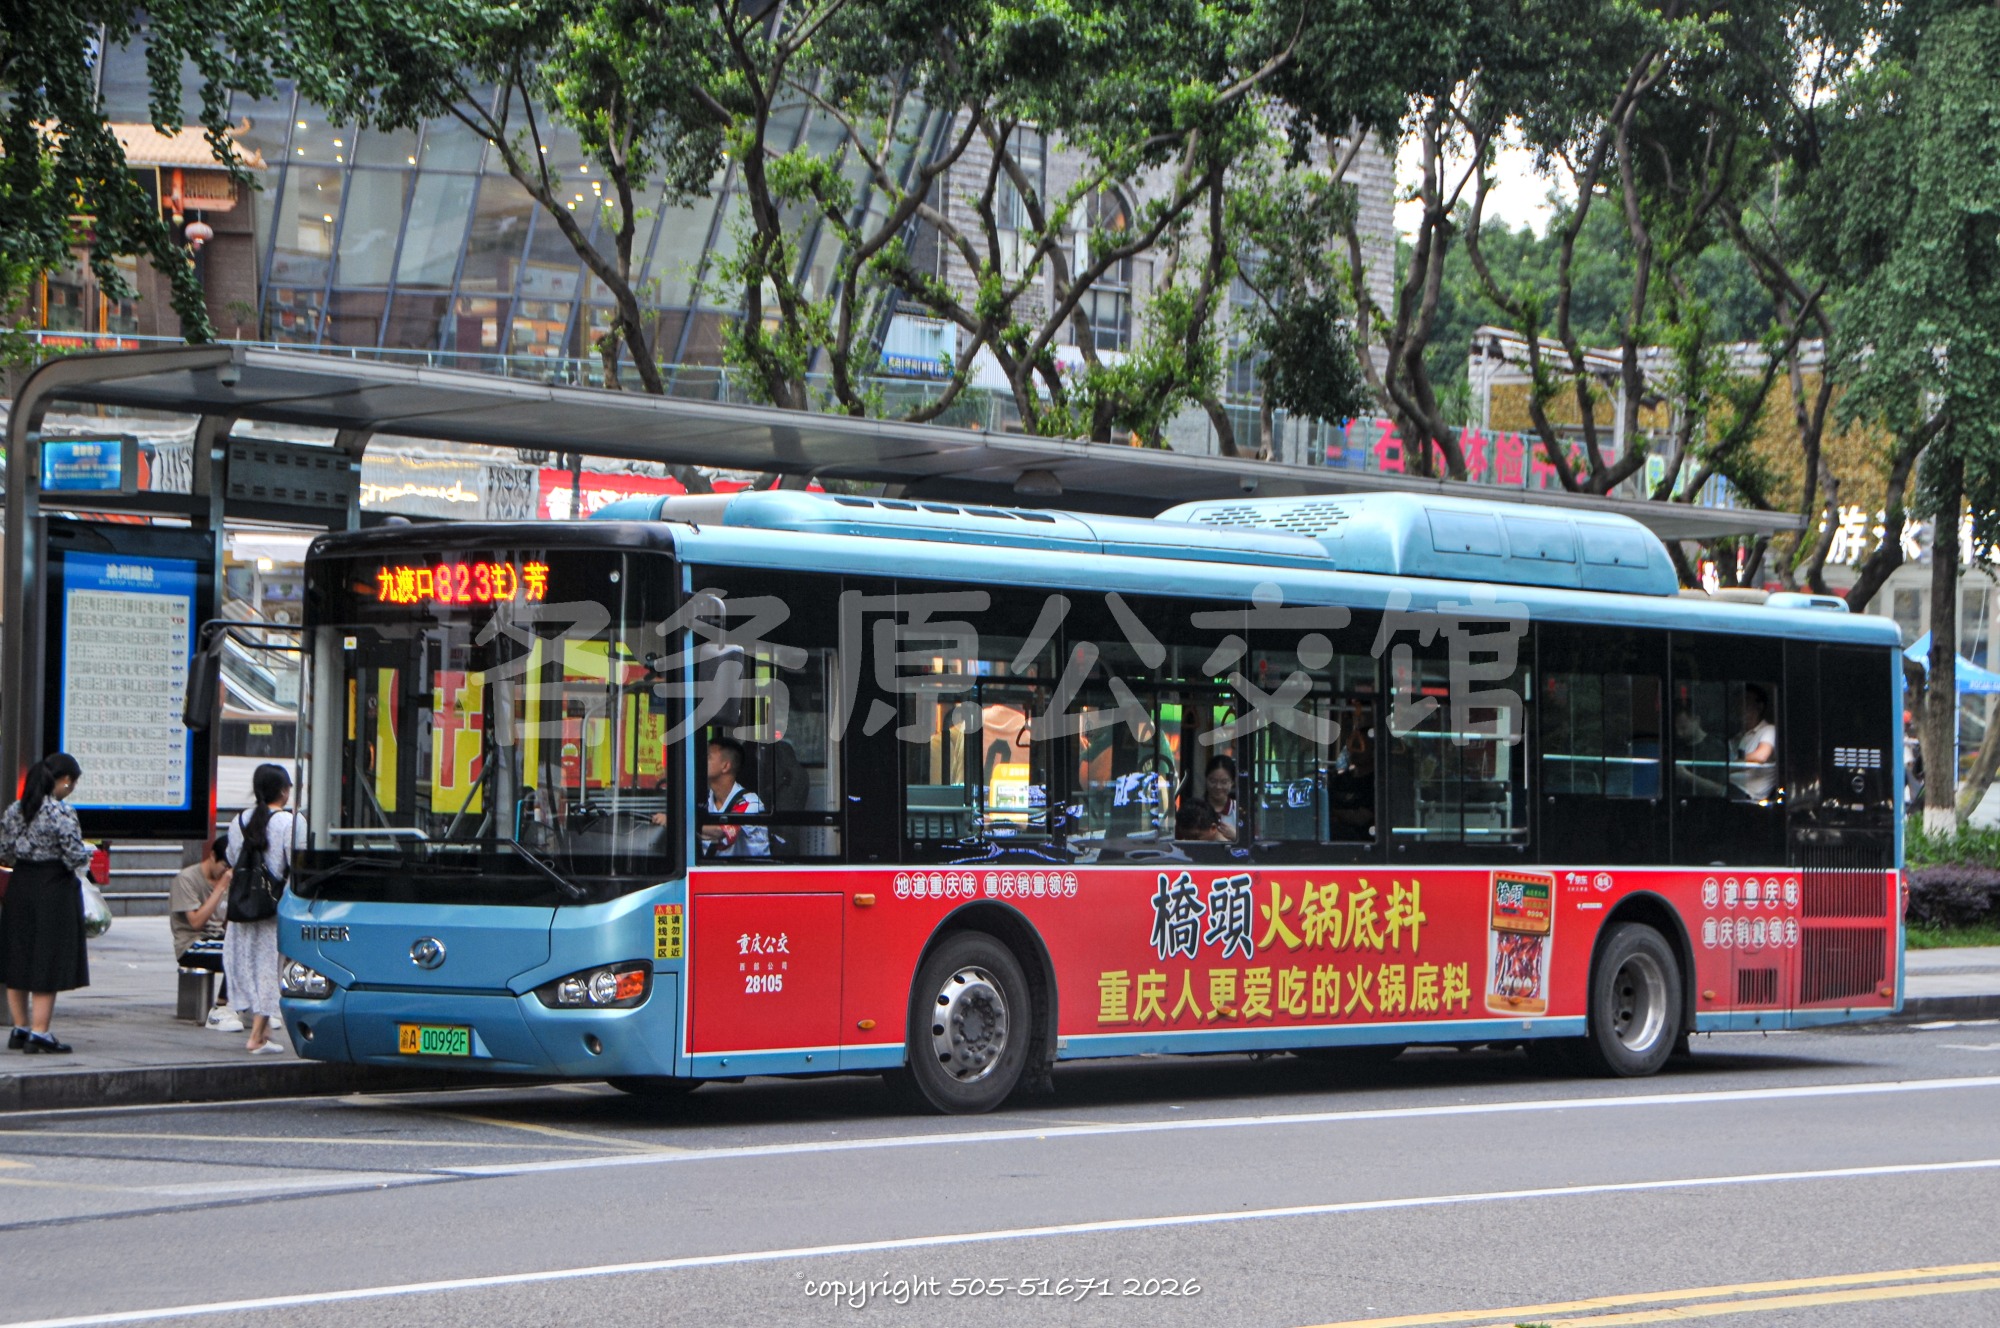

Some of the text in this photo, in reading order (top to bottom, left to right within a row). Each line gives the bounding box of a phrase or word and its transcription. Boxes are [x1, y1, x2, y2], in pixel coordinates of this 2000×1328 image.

[436, 563, 491, 602] 823
[893, 872, 1078, 899] 地道重庆味 重庆销量领先
[1702, 877, 1800, 910] 地道重庆味
[1258, 878, 1427, 953] 火锅底料
[301, 925, 350, 942] HIGER
[657, 916, 668, 958] 视线盲区
[671, 915, 681, 957] 请勿靠近
[736, 932, 791, 955] 重庆公交
[1702, 917, 1800, 949] 重庆销量领先
[745, 974, 783, 993] 28105
[1097, 961, 1472, 1023] 重庆人更爱吃的火锅底料
